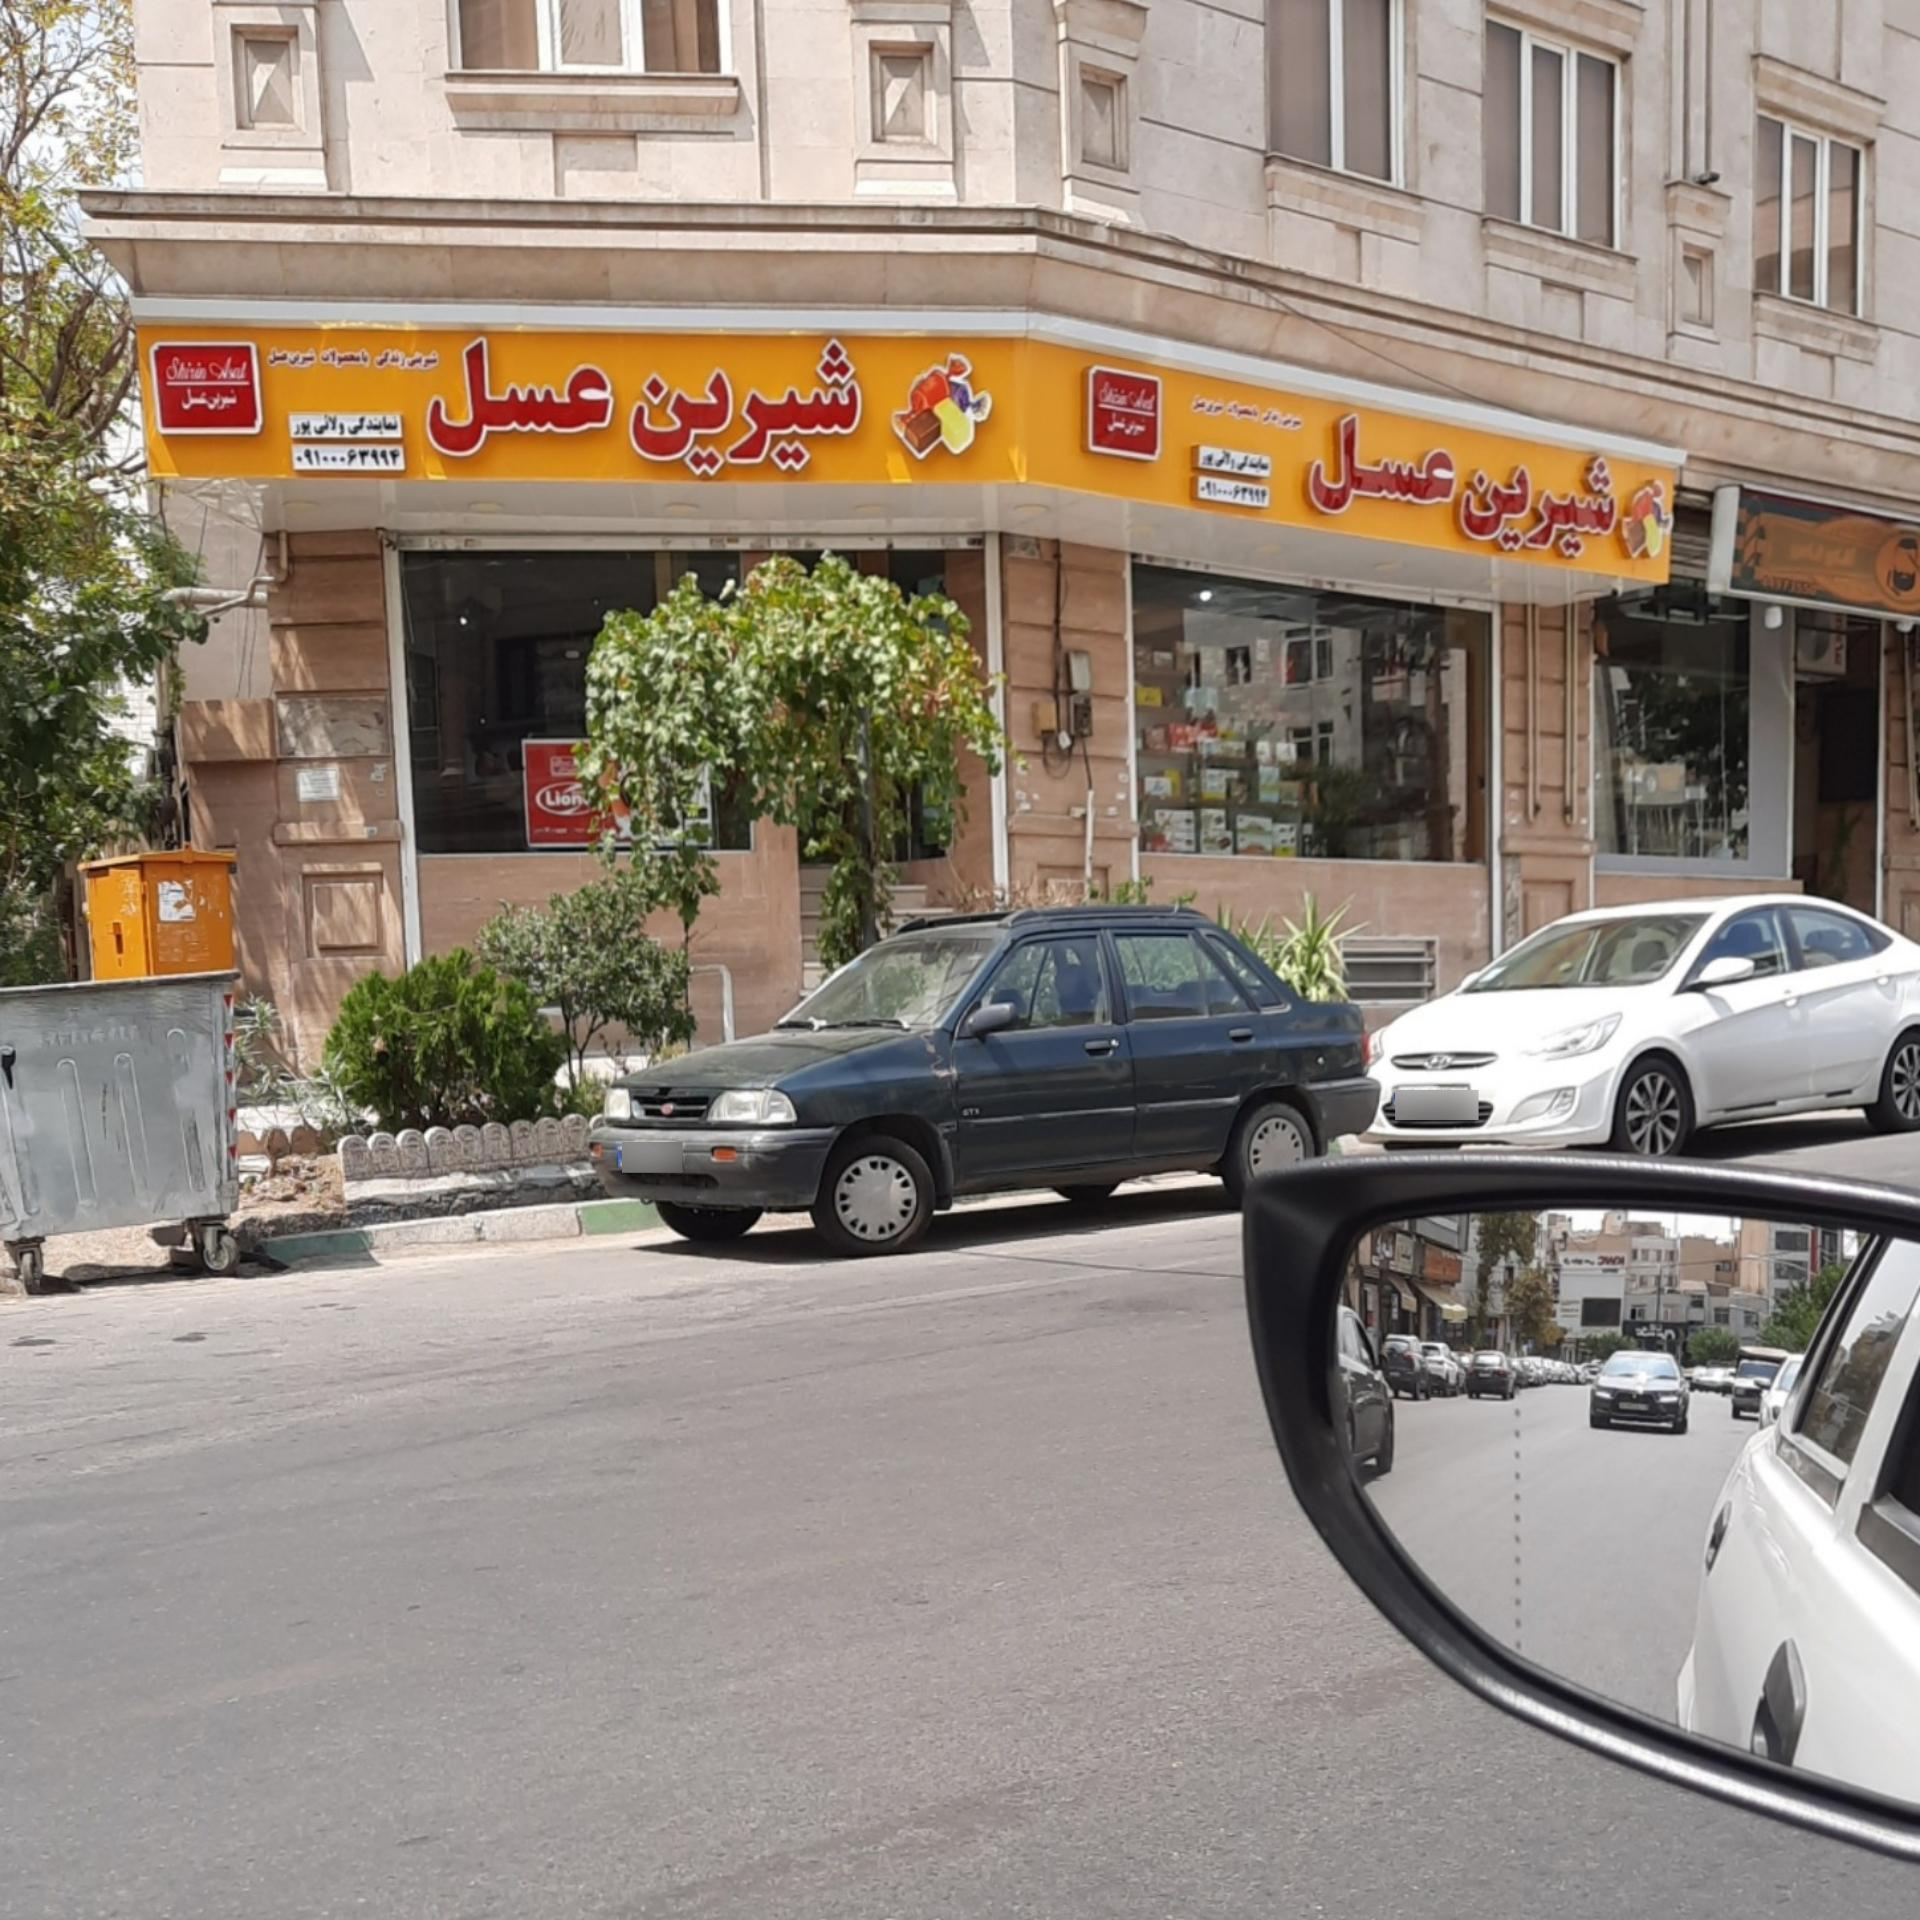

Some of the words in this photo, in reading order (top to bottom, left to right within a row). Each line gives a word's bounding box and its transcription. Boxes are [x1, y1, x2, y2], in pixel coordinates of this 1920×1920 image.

[166, 356, 207, 380] Shirin
[209, 357, 247, 380] Asal
[426, 337, 615, 457] عسل
[294, 420, 311, 435] پور
[348, 415, 398, 435] نمایندگی
[629, 338, 862, 475] شیرین
[296, 448, 400, 466] ۰۹۱۰۰۰۶۳۹۹۴
[1308, 413, 1456, 514] عسل
[1461, 456, 1618, 557] شیرین
